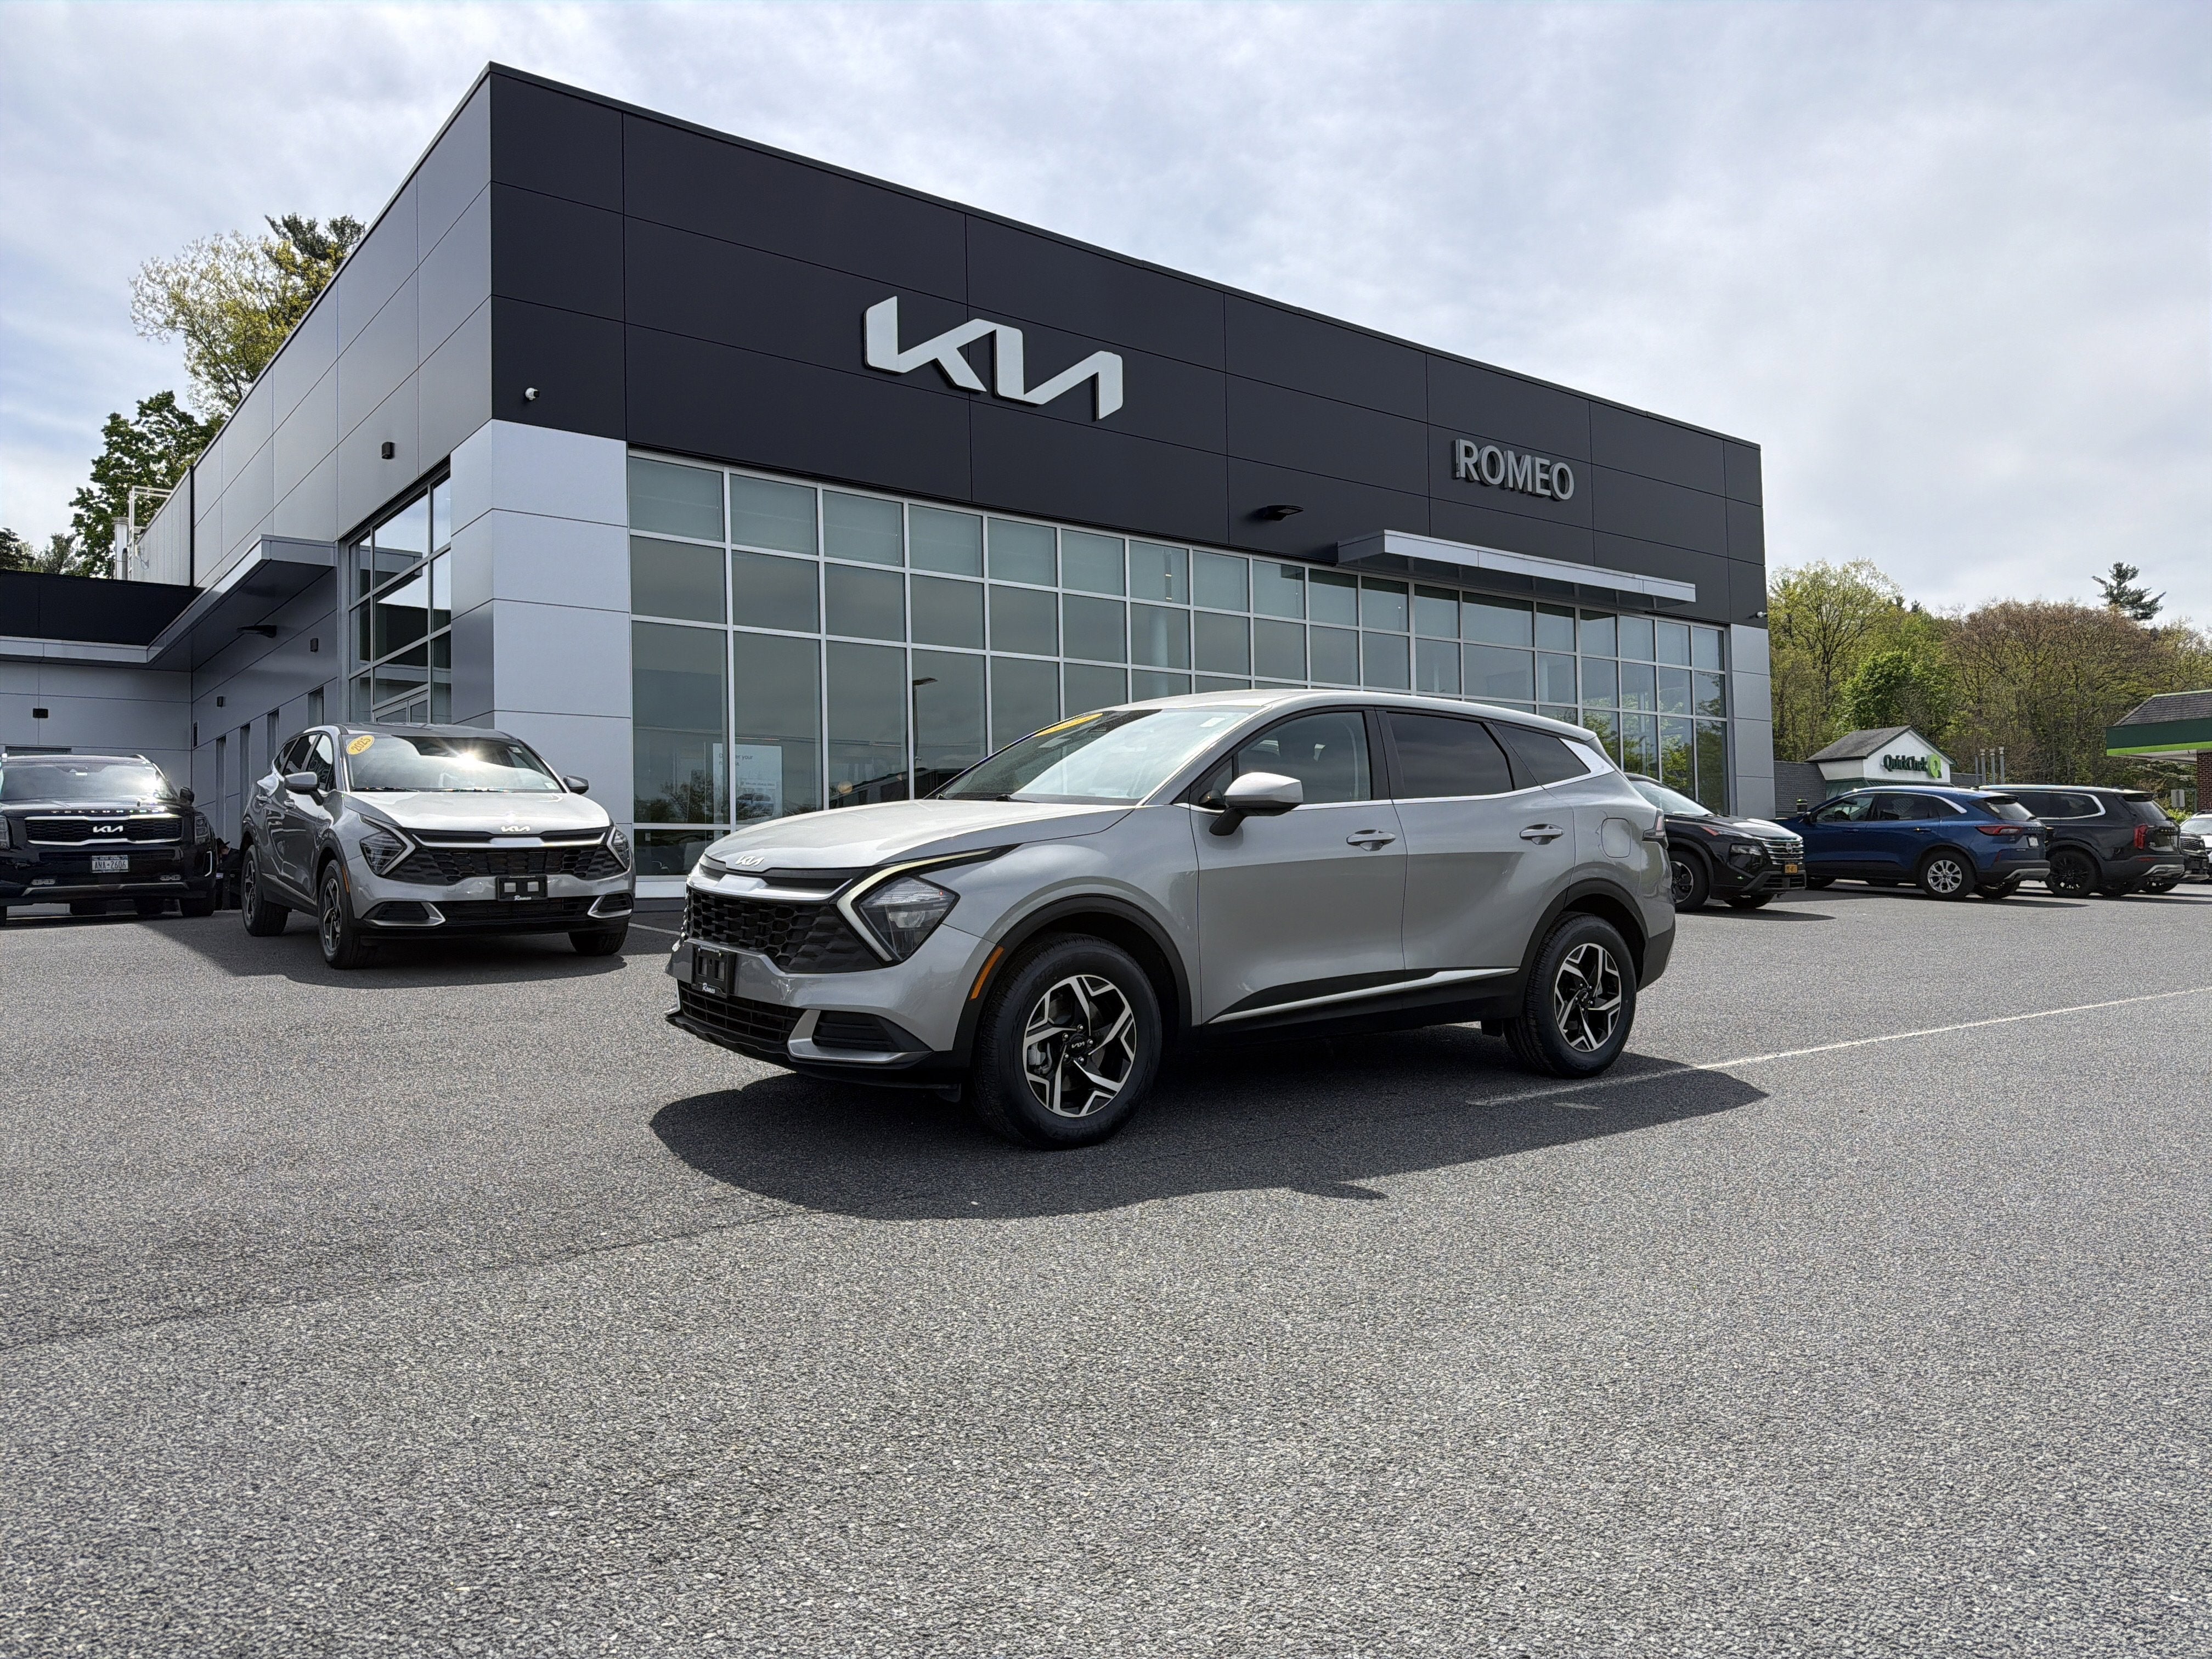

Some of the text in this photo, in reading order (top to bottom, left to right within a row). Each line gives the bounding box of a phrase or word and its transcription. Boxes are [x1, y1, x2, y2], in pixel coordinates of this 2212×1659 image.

[864, 295, 1124, 420] KIA
[1454, 438, 1575, 500] ROMEO
[351, 737, 371, 752] 2025
[95, 860, 126, 869] ANA 2606
[735, 855, 765, 867] KIA
